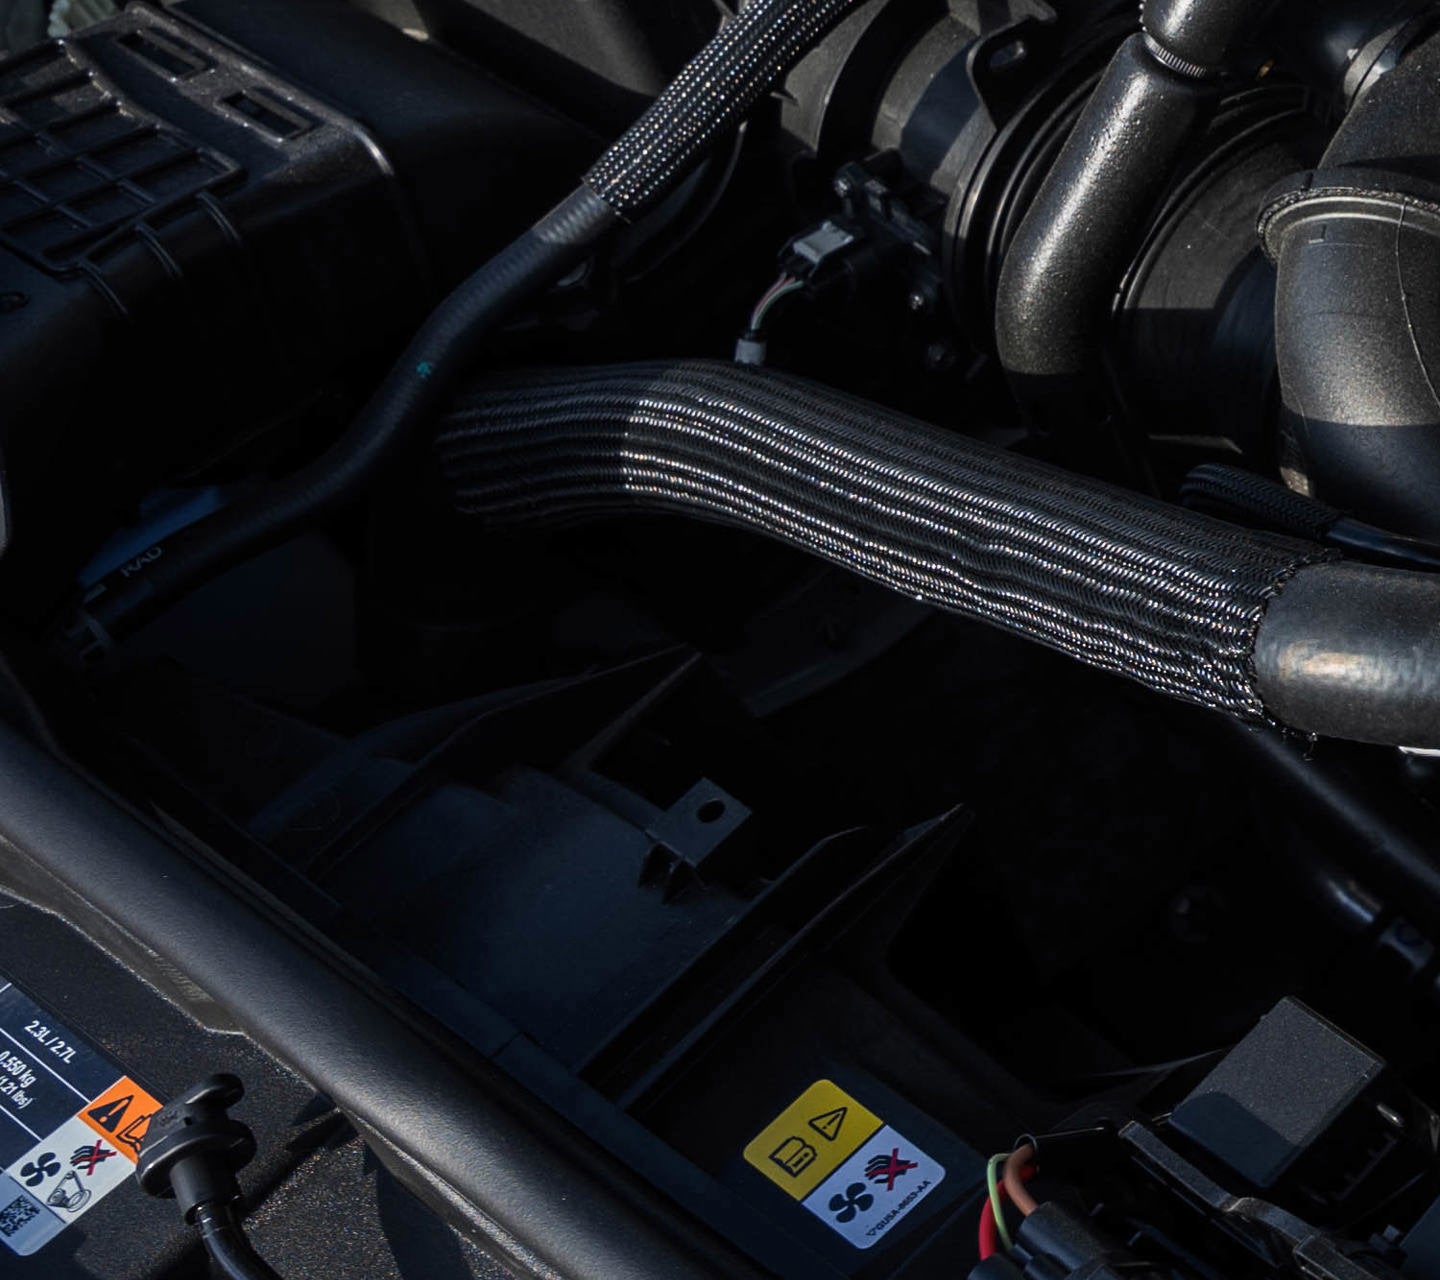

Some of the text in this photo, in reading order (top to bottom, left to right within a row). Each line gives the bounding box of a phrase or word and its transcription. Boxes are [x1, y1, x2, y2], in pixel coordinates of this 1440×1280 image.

[23, 1016, 51, 1043] 2.3L
[49, 1037, 77, 1064] 2.7L
[15, 1066, 39, 1091] kg
